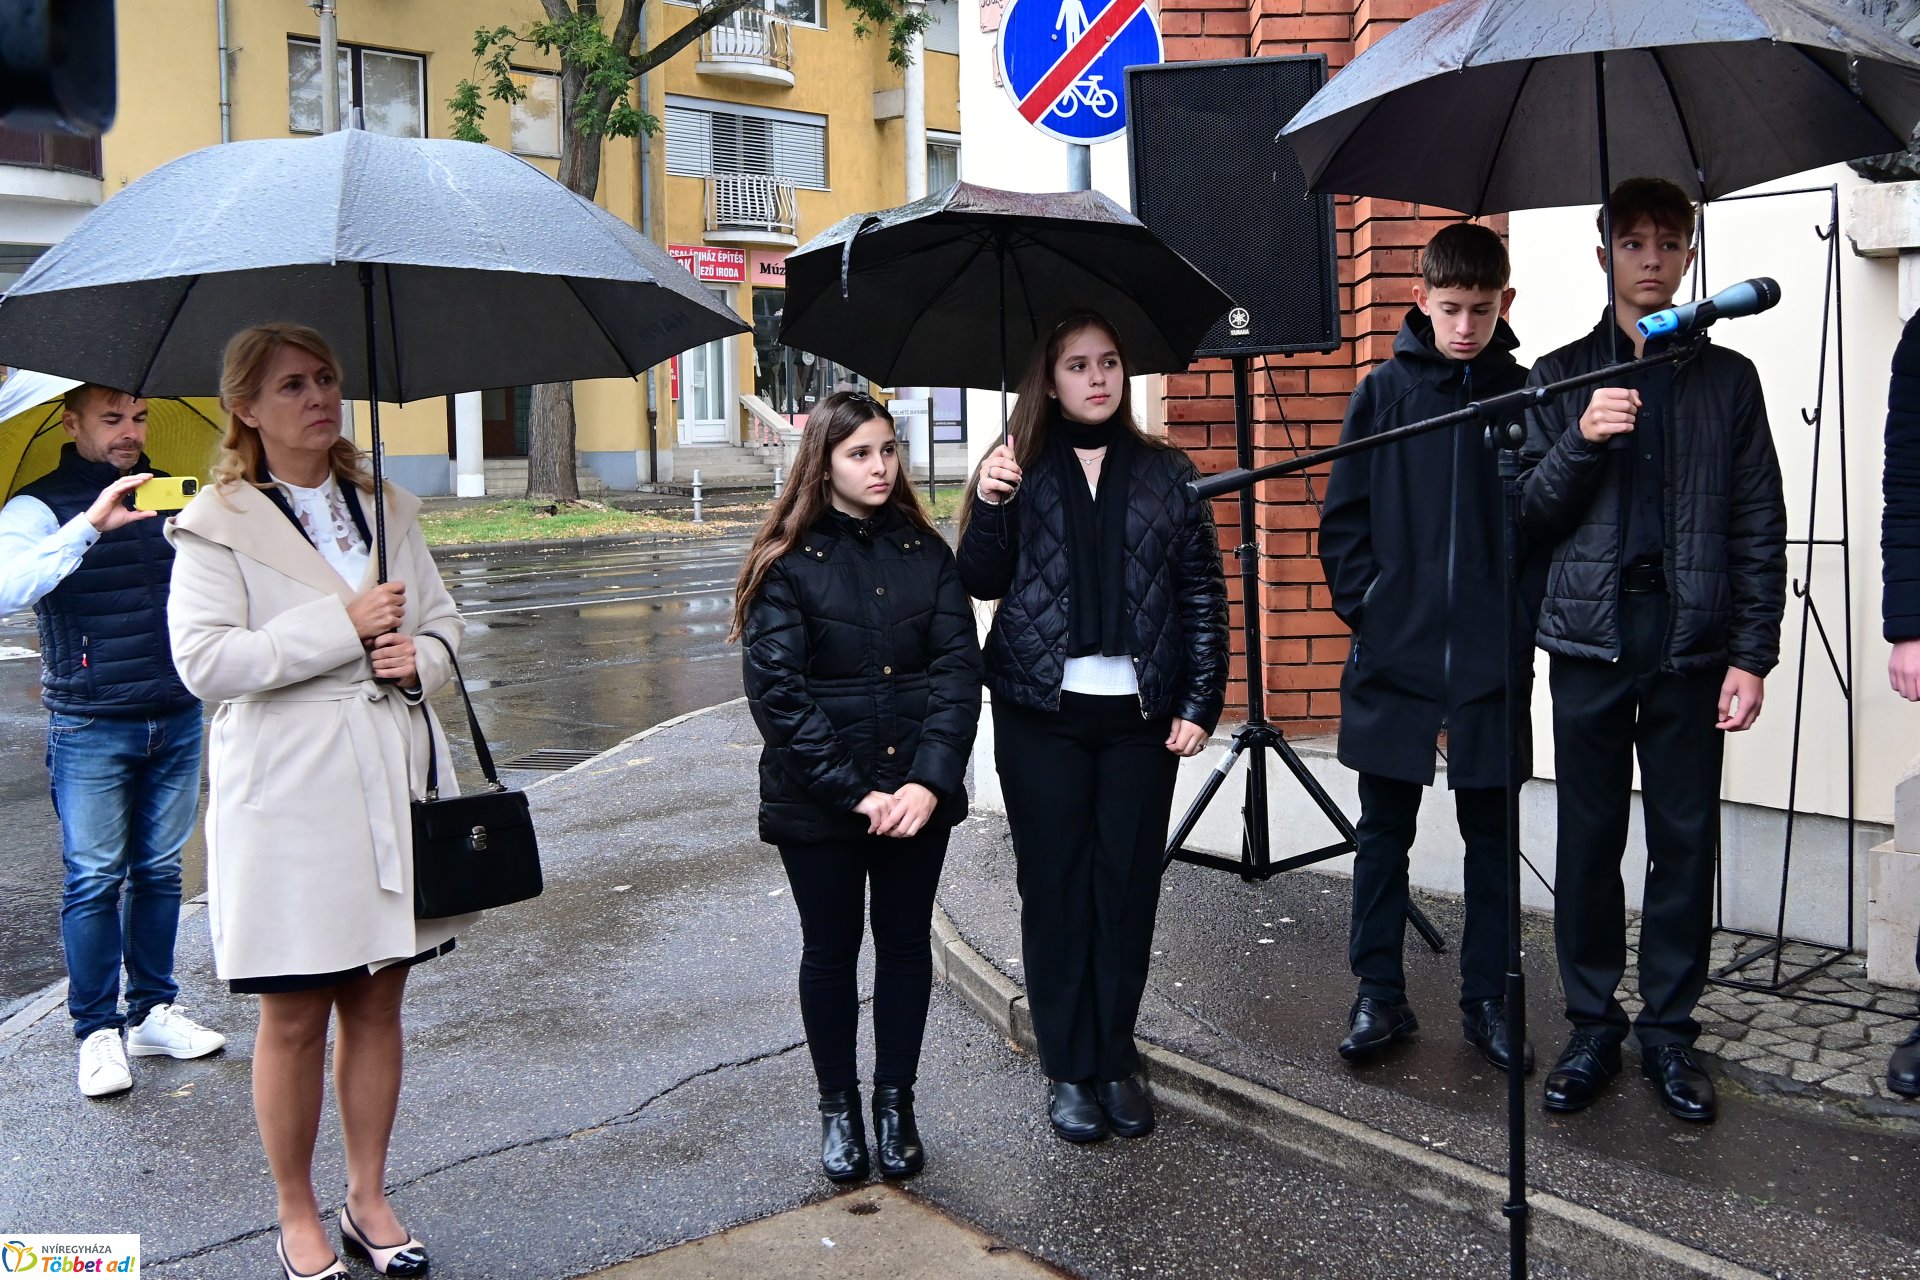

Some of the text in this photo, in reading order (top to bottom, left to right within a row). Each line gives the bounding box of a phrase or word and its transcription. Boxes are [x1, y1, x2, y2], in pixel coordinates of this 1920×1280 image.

[718, 250, 744, 264] ÉPÍTÉS
[700, 264, 739, 278] EZŐ IRODA
[759, 262, 785, 275] Múz
